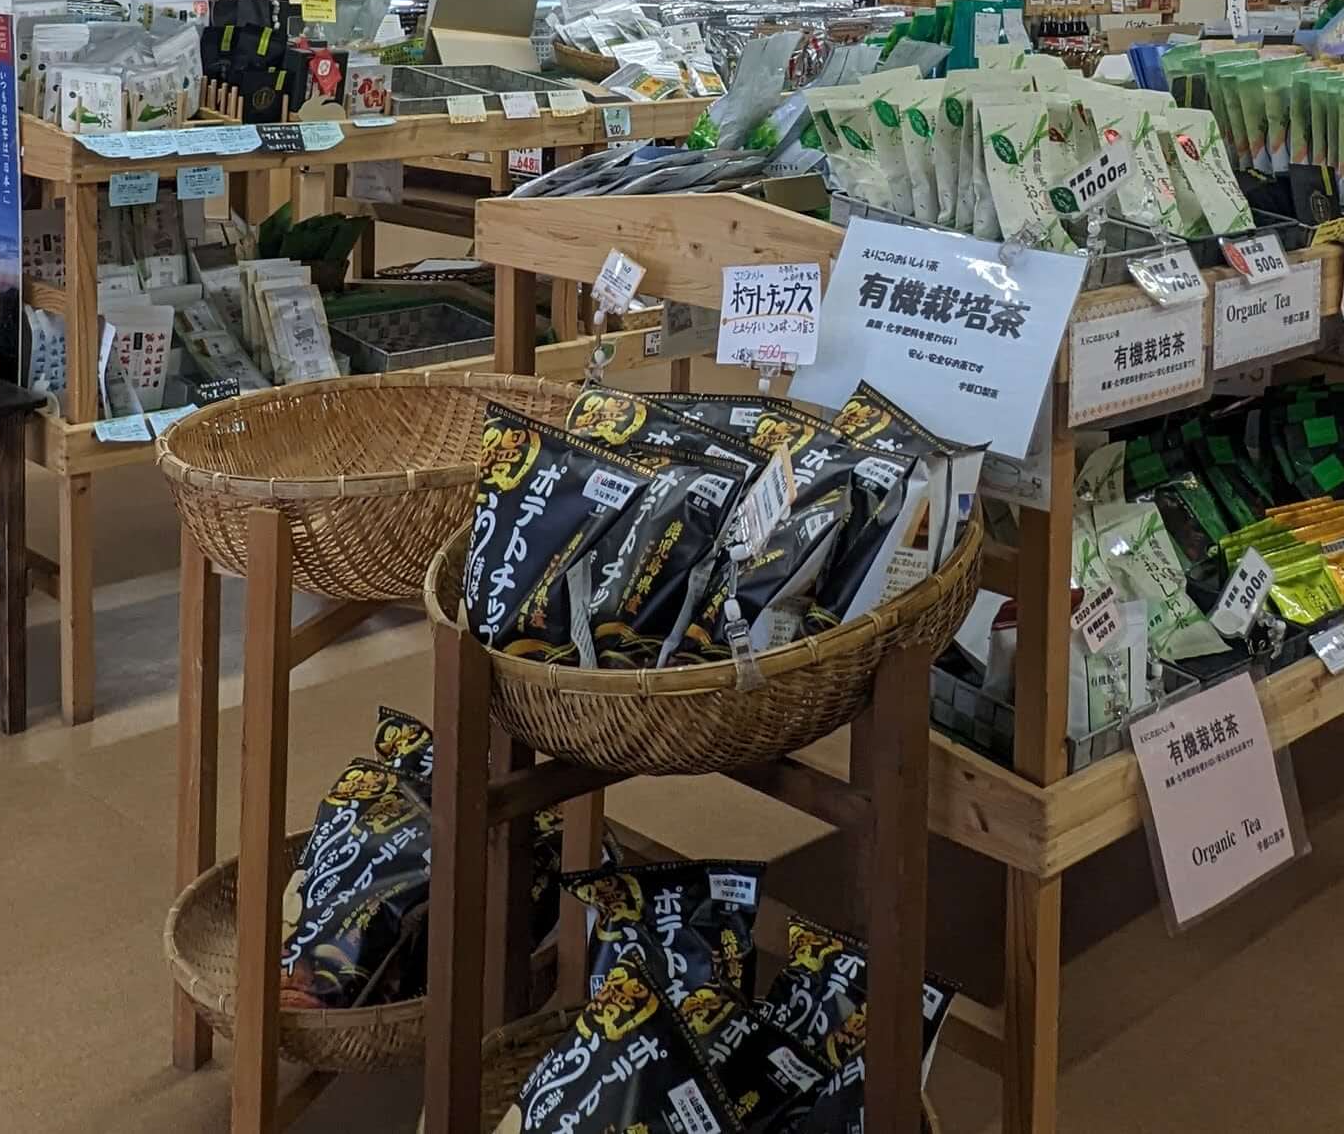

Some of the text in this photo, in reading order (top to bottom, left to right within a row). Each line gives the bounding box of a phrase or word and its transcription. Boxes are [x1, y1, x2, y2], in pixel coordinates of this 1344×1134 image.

[1079, 161, 1128, 203] 1000円
[862, 248, 941, 272] えりこのおいしい茶
[1255, 255, 1284, 274] 500円
[730, 282, 814, 315] ポテトチップス
[859, 272, 1031, 340] 有機栽培茶
[1225, 292, 1291, 324] Organic Tea
[1113, 330, 1186, 372] 有機栽培茶
[1238, 569, 1268, 610] 300円
[1166, 713, 1241, 767] 有機栽培茶
[1191, 816, 1263, 867] Organic Tea
